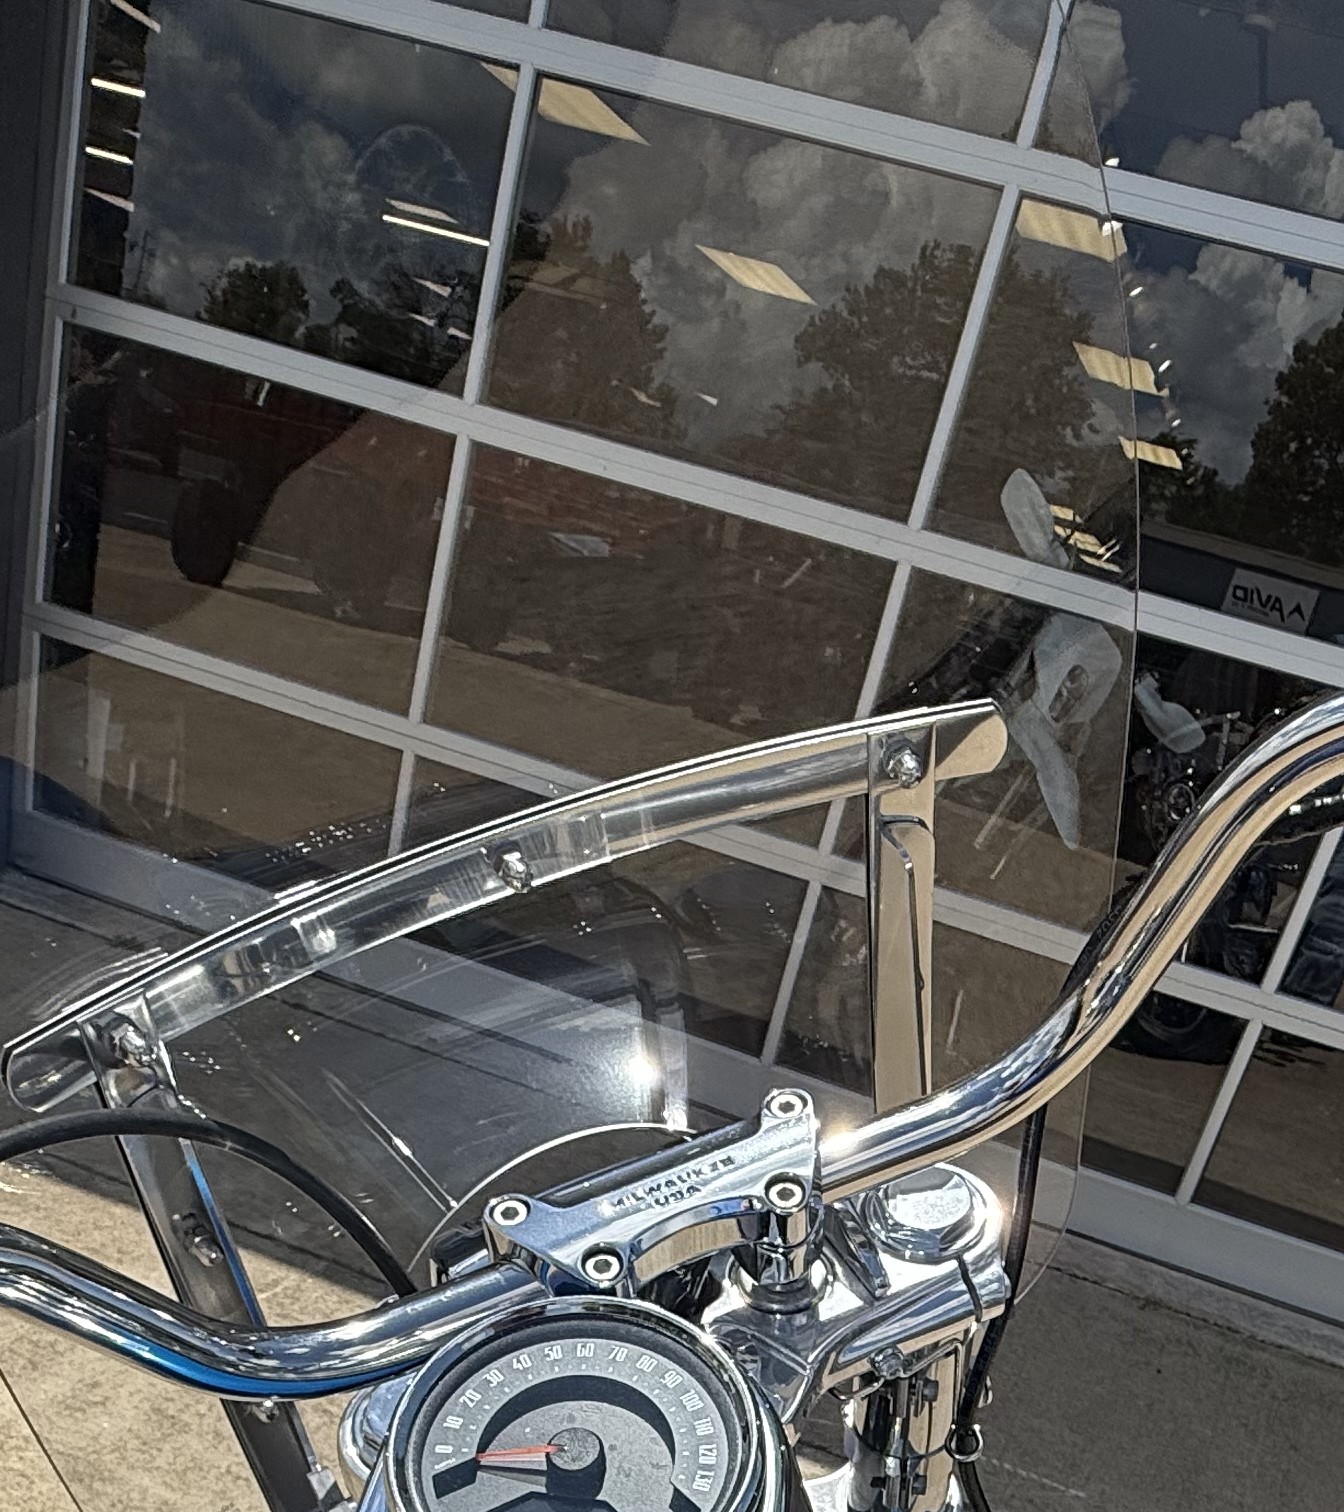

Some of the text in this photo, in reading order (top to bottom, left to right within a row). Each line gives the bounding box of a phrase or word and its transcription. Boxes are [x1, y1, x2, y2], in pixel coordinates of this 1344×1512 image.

[544, 1345, 563, 1362] 50
[575, 1343, 594, 1358] 60
[609, 1345, 629, 1363] 70
[512, 1353, 533, 1373] 40
[635, 1354, 659, 1374] 80
[483, 1368, 505, 1388] 30
[659, 1369, 683, 1389] 90
[459, 1389, 482, 1409] 20
[678, 1389, 704, 1412] 100
[442, 1415, 464, 1431] 10
[692, 1416, 714, 1436] 110
[434, 1443, 454, 1455] 0
[697, 1443, 718, 1467] 120
[692, 1470, 712, 1492] 130
